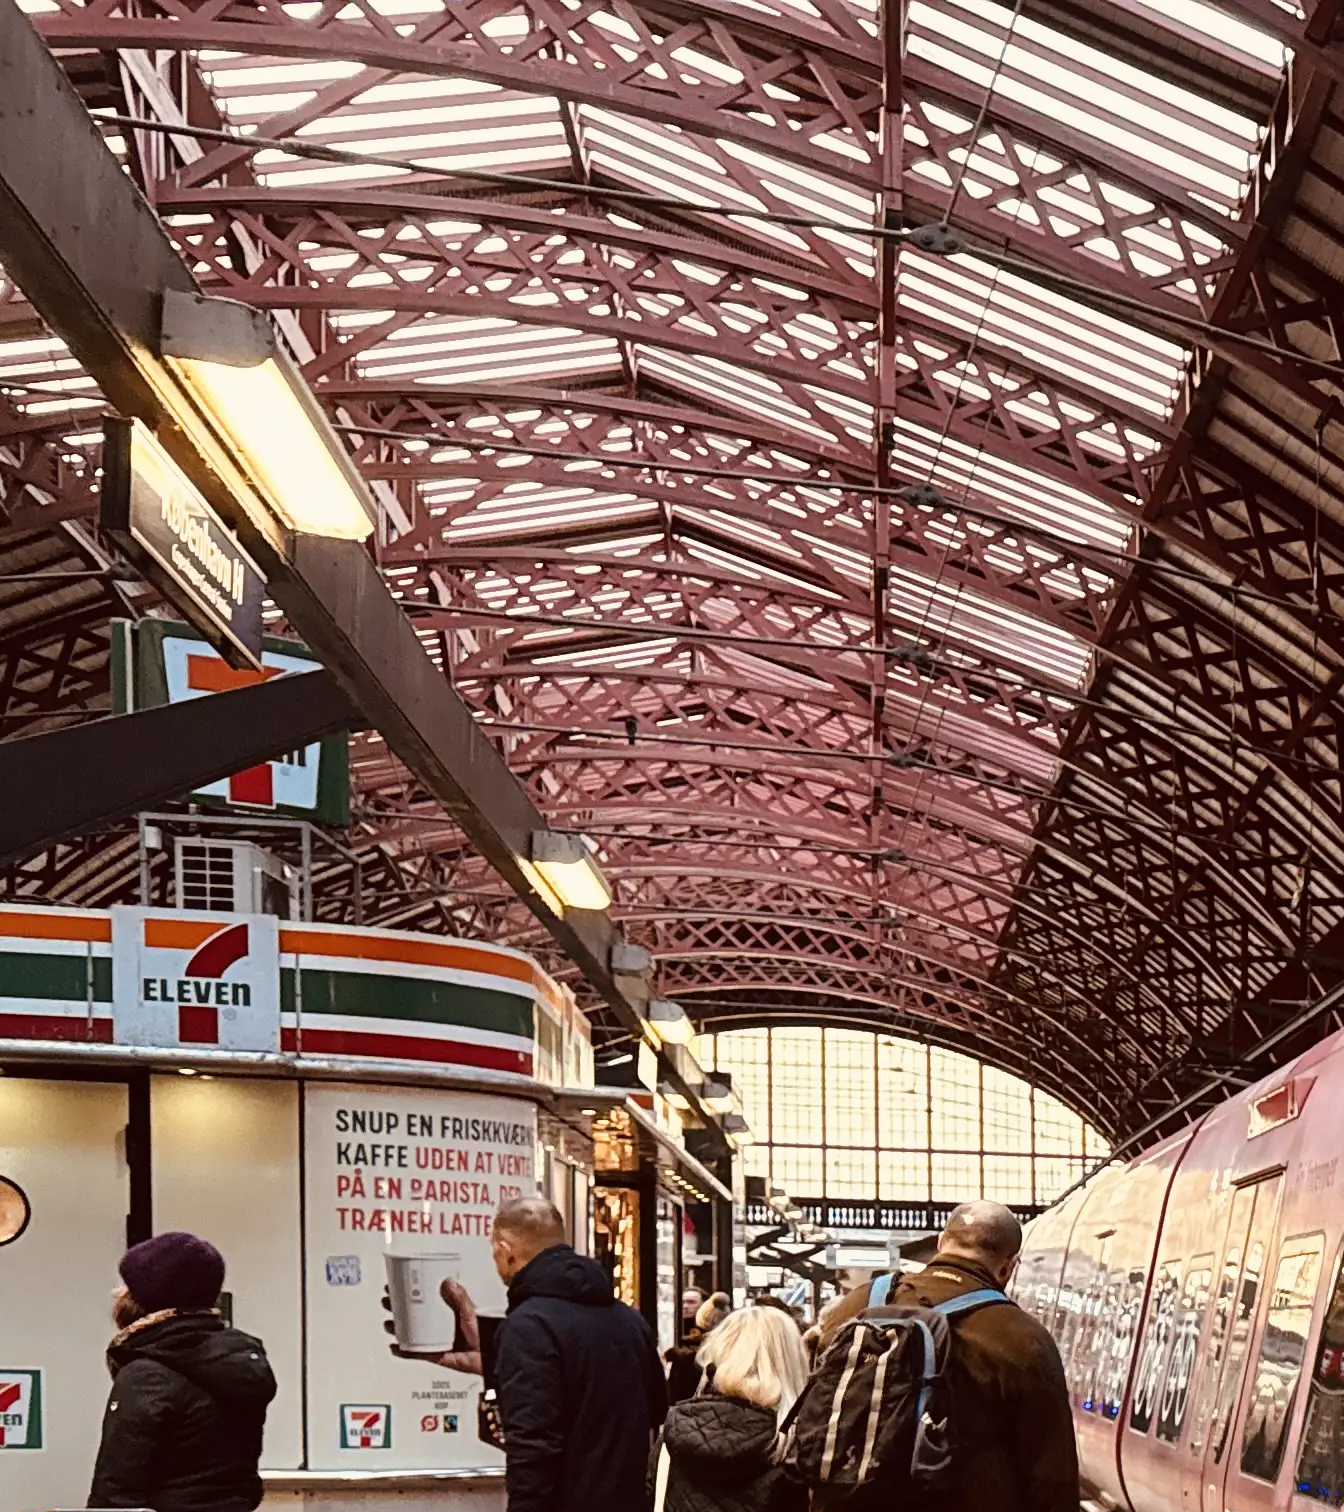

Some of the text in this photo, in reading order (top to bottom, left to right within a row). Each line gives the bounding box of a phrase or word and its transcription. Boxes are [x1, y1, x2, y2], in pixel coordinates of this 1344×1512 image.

[144, 918, 249, 1044] 7
[335, 1109, 399, 1135] SNUP
[407, 1113, 433, 1138] EN
[336, 1142, 408, 1168] KAFFE
[415, 1147, 468, 1172] UDEN
[474, 1152, 494, 1173] AT
[337, 1168, 366, 1198] PÅ
[374, 1177, 402, 1200] EN
[336, 1208, 433, 1234] TRÆNER
